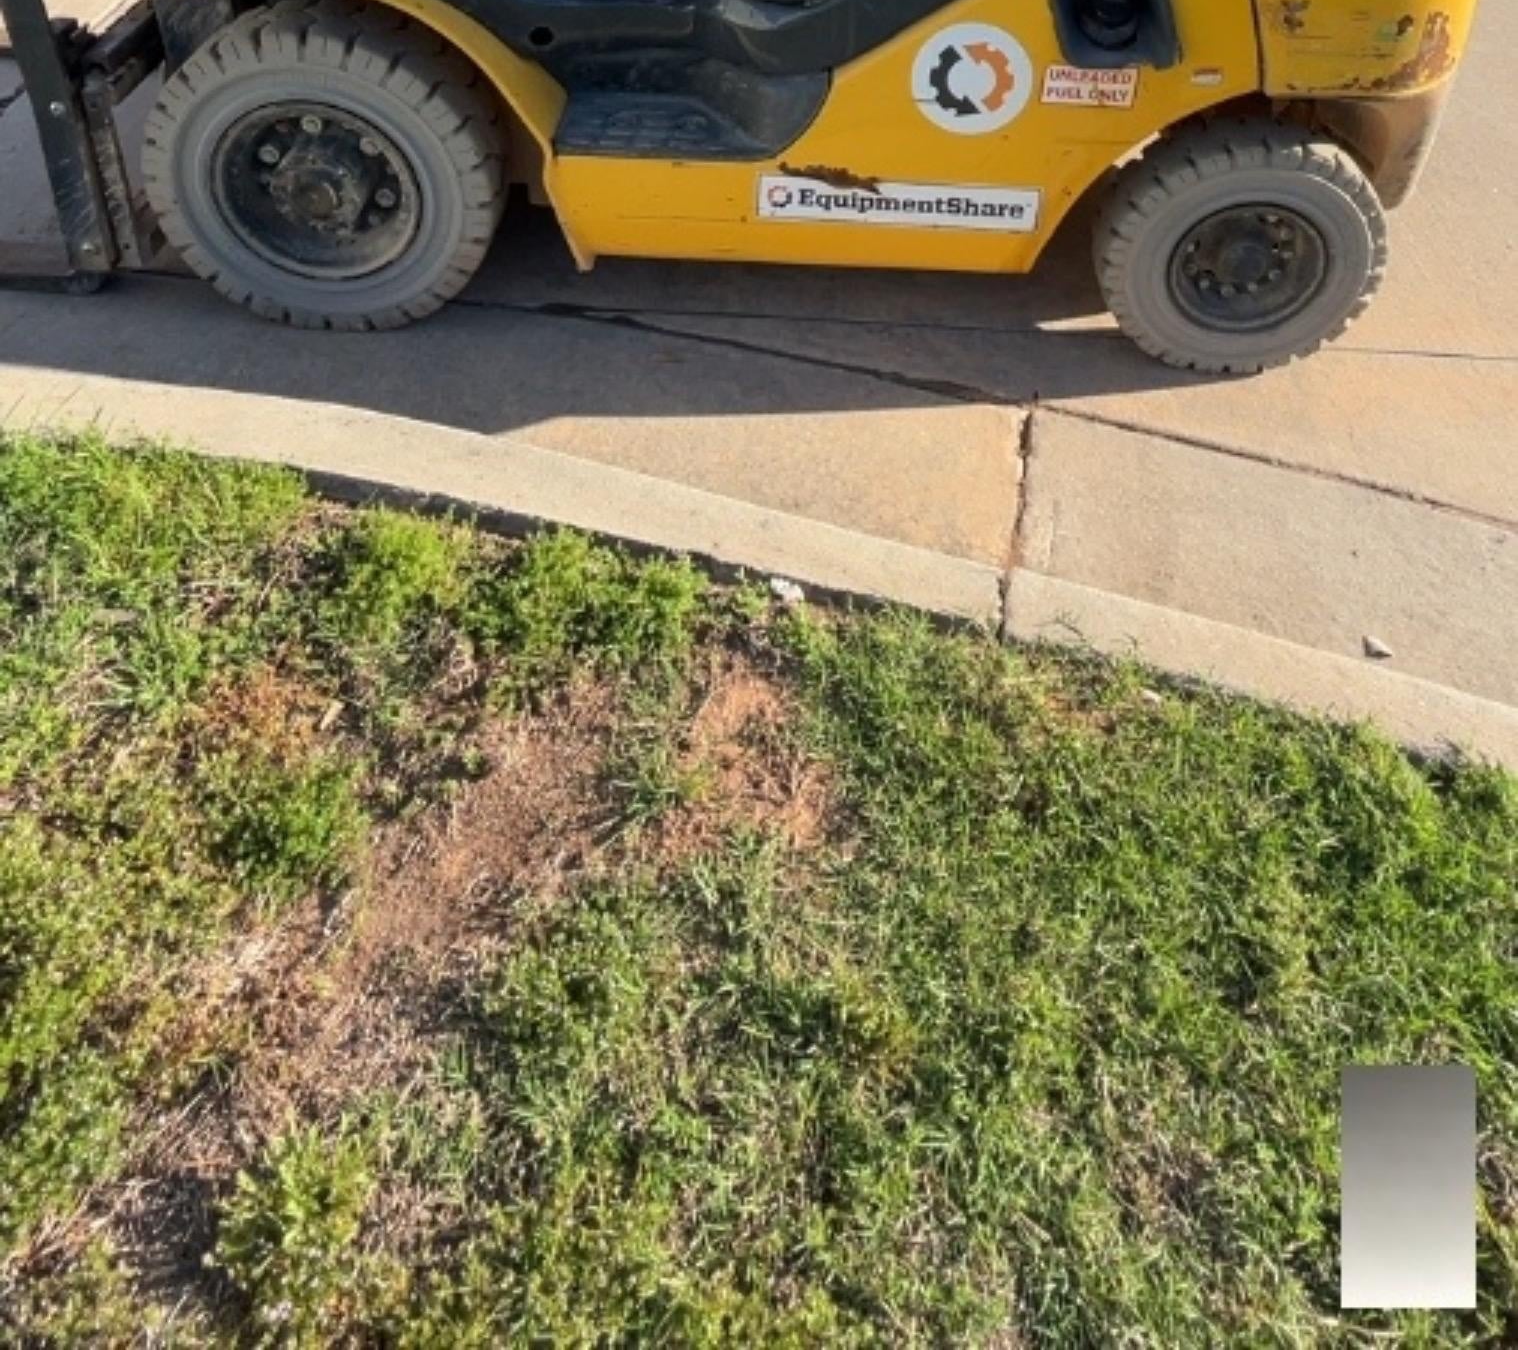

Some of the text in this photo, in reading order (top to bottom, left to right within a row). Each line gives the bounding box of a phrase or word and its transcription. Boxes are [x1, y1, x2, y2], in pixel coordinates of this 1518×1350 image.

[1049, 68, 1132, 84] UNLEADED
[1046, 86, 1130, 103] FUEL ONLY
[798, 188, 1025, 219] EquipmentShare
